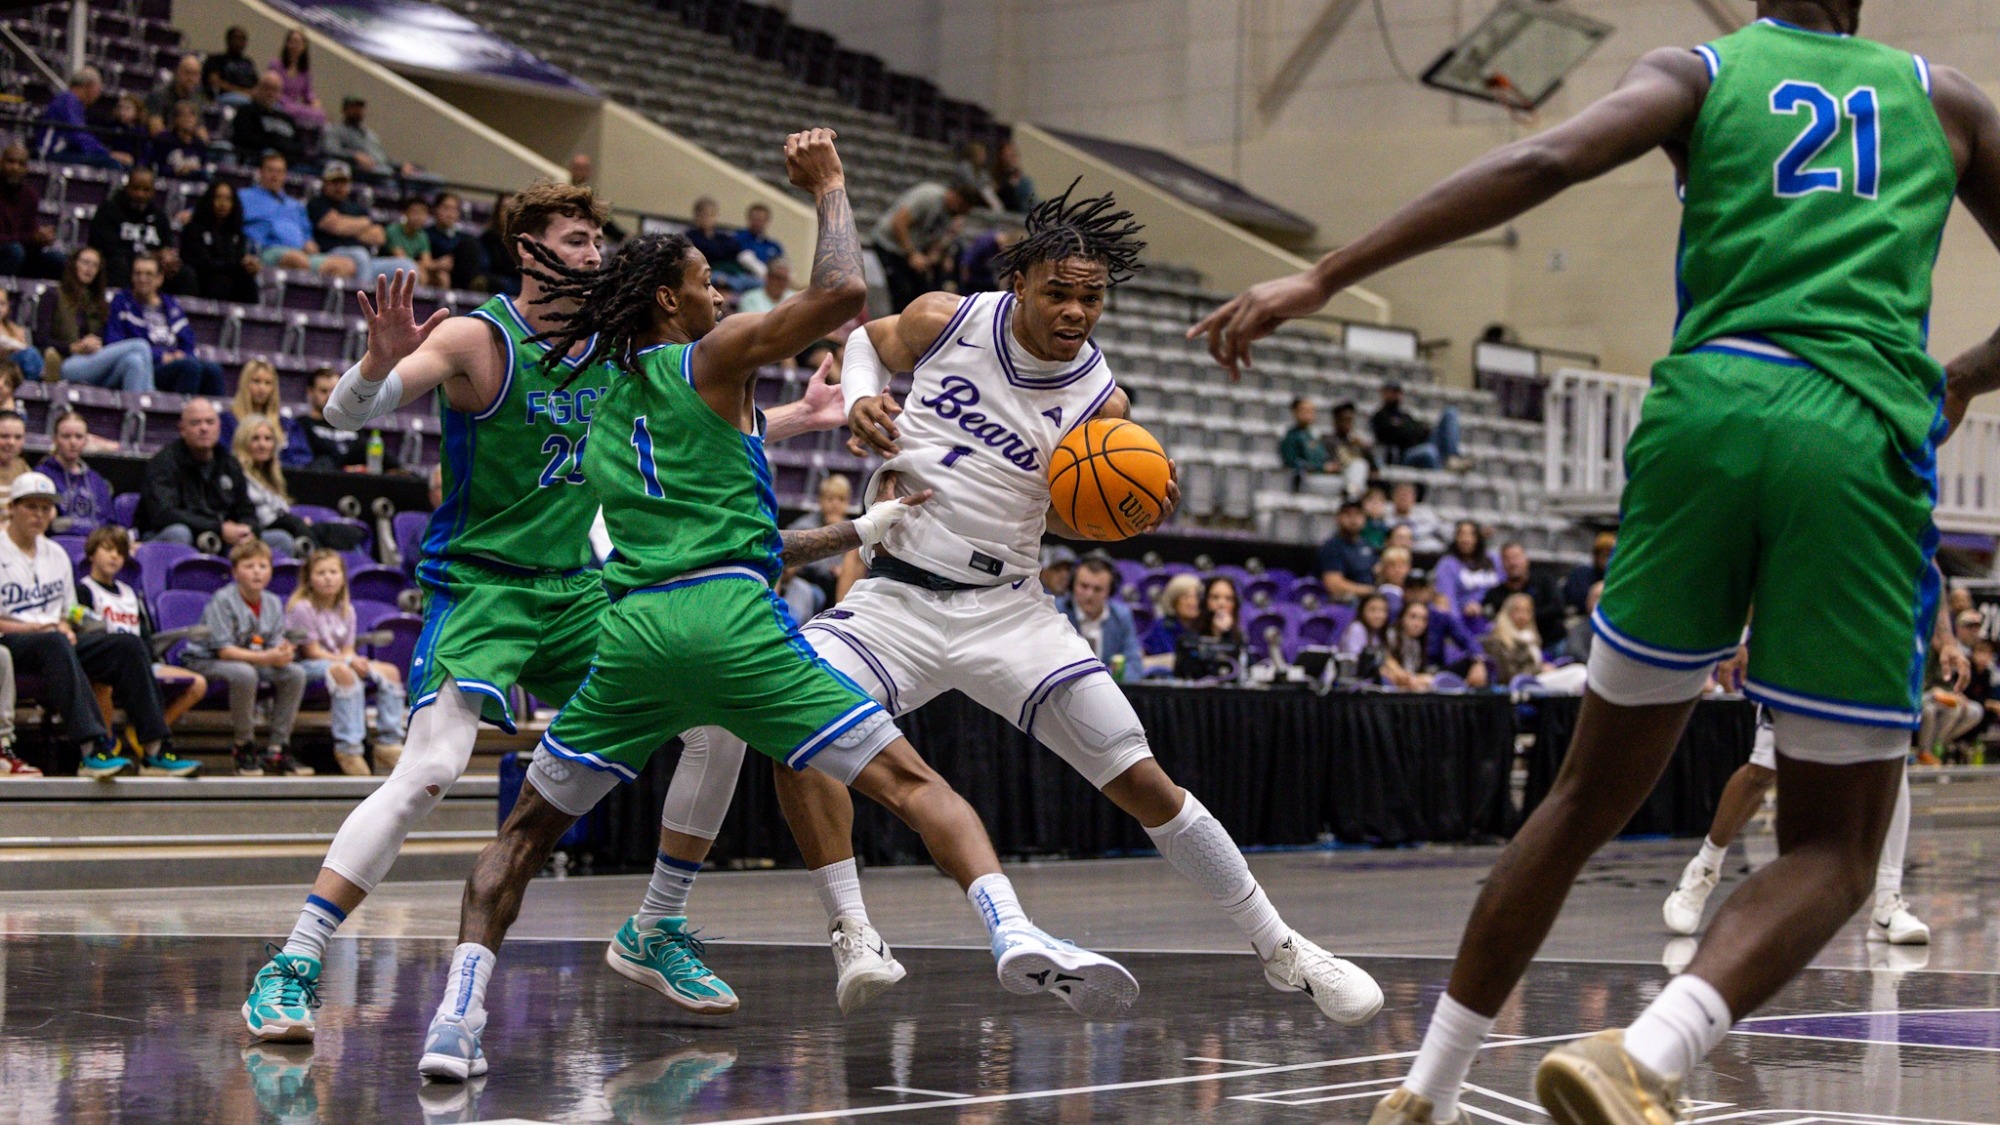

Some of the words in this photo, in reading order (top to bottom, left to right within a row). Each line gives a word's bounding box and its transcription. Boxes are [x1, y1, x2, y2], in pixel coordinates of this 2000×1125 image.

[1769, 79, 1880, 200] 21
[526, 387, 608, 425] FGC
[921, 375, 1040, 472] Bears
[631, 415, 666, 499] 1
[1118, 491, 1152, 528] Wil
